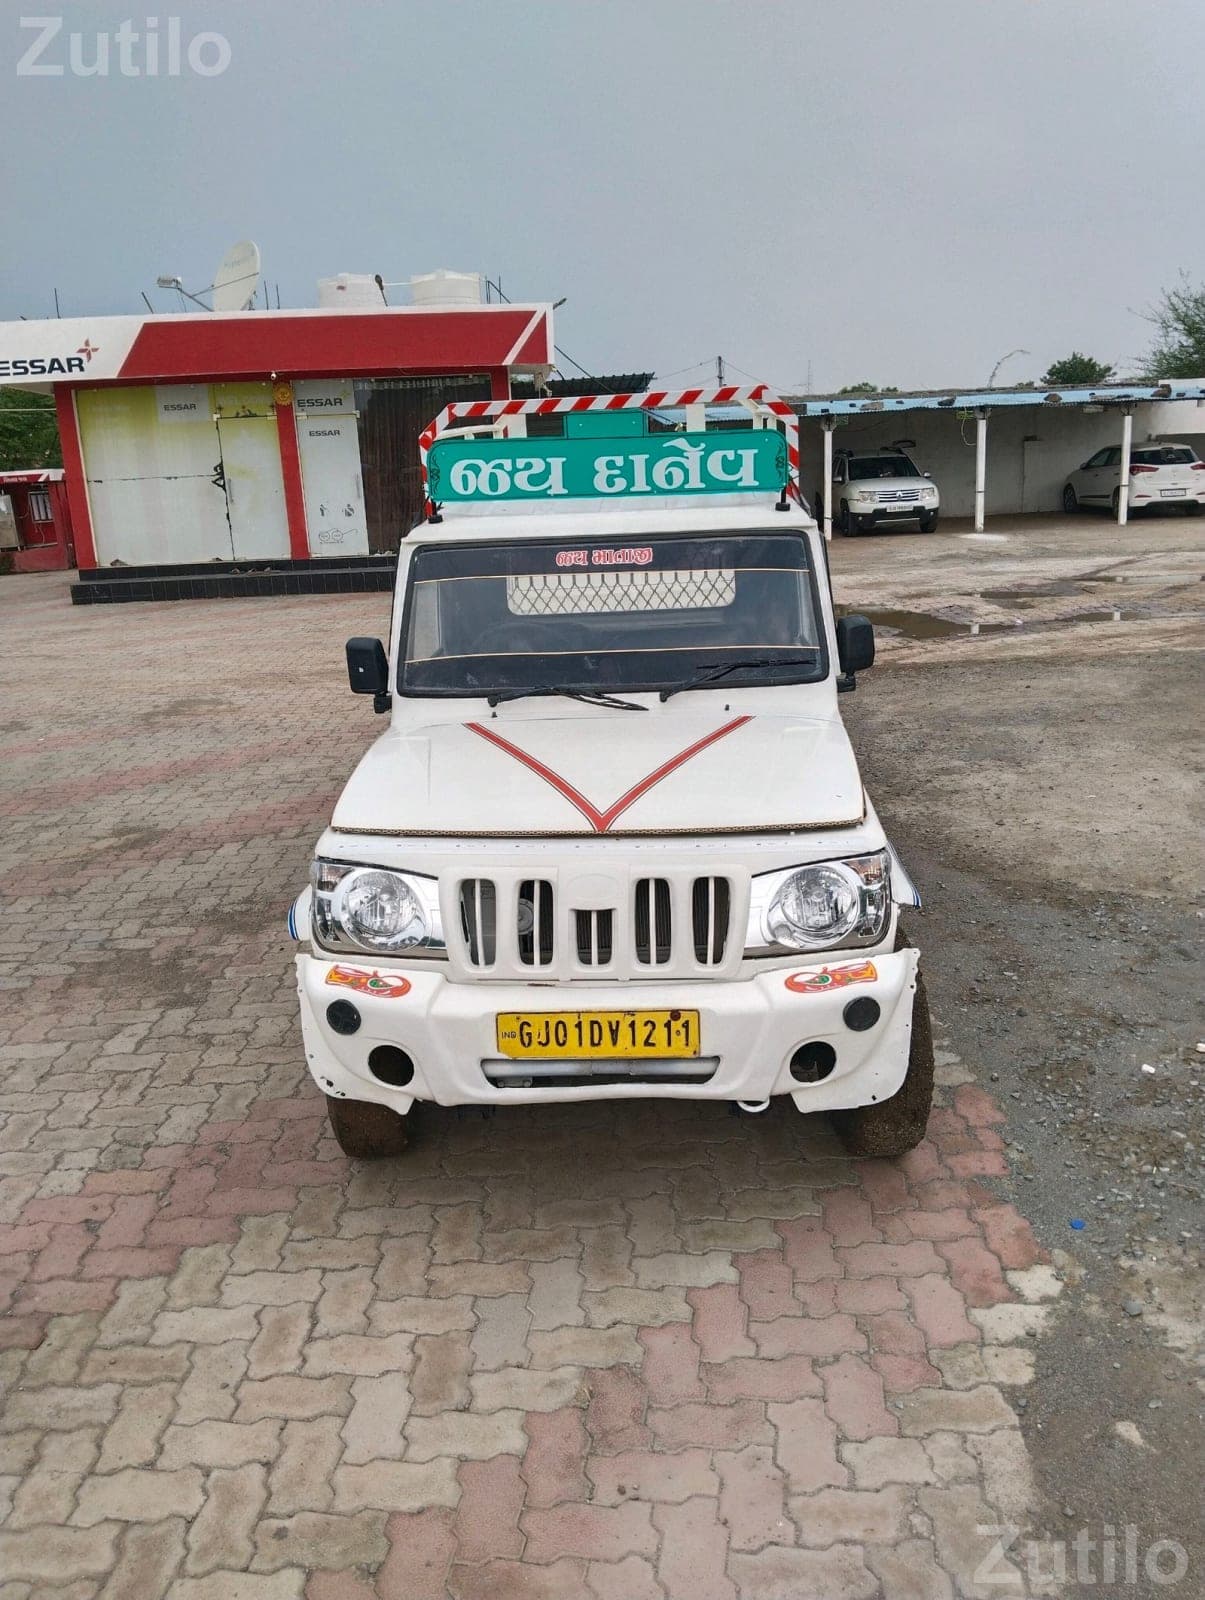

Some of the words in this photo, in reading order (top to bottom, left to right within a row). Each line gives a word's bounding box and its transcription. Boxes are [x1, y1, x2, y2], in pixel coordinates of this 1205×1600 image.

[163, 403, 197, 411] ESSAR
[297, 397, 343, 408] ESSAR
[309, 429, 341, 437] ESSAR
[449, 457, 568, 496] જય
[556, 550, 588, 566] જય
[592, 547, 653, 565] માતાજી
[519, 1019, 690, 1048] GJ01DV1211
